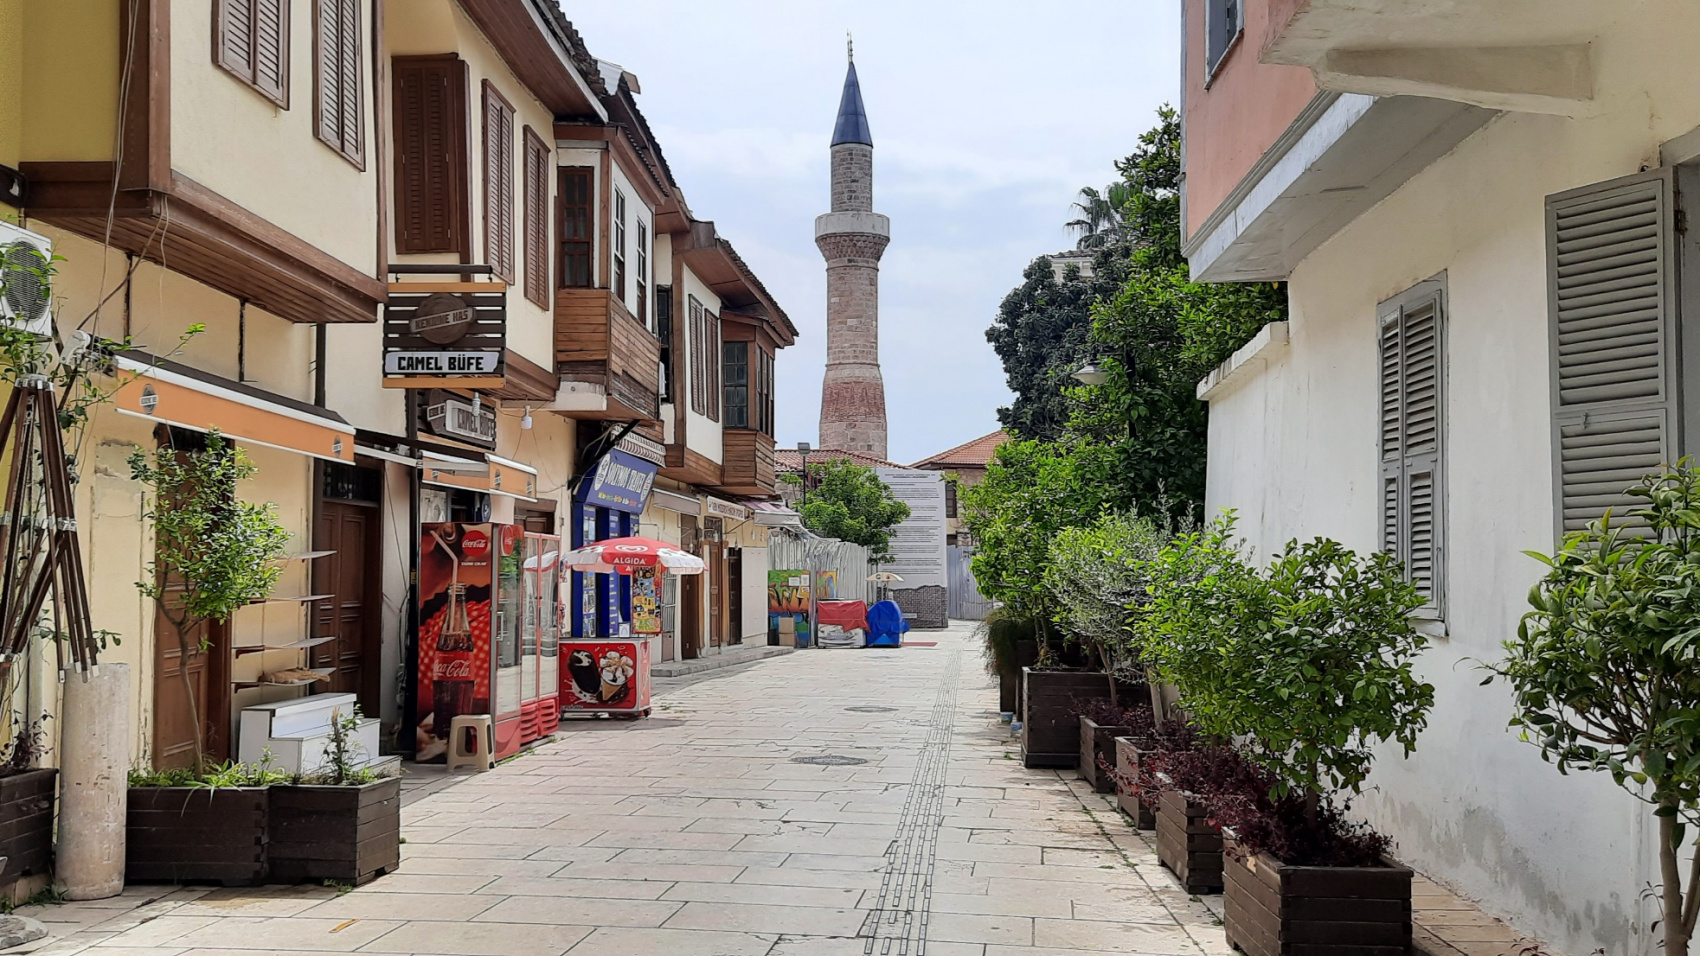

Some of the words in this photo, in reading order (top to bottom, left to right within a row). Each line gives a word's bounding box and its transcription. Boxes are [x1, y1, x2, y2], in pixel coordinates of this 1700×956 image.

[397, 356, 443, 371] CAMEL
[447, 354, 484, 371] BÜFE
[613, 557, 646, 565] ALGIDA
